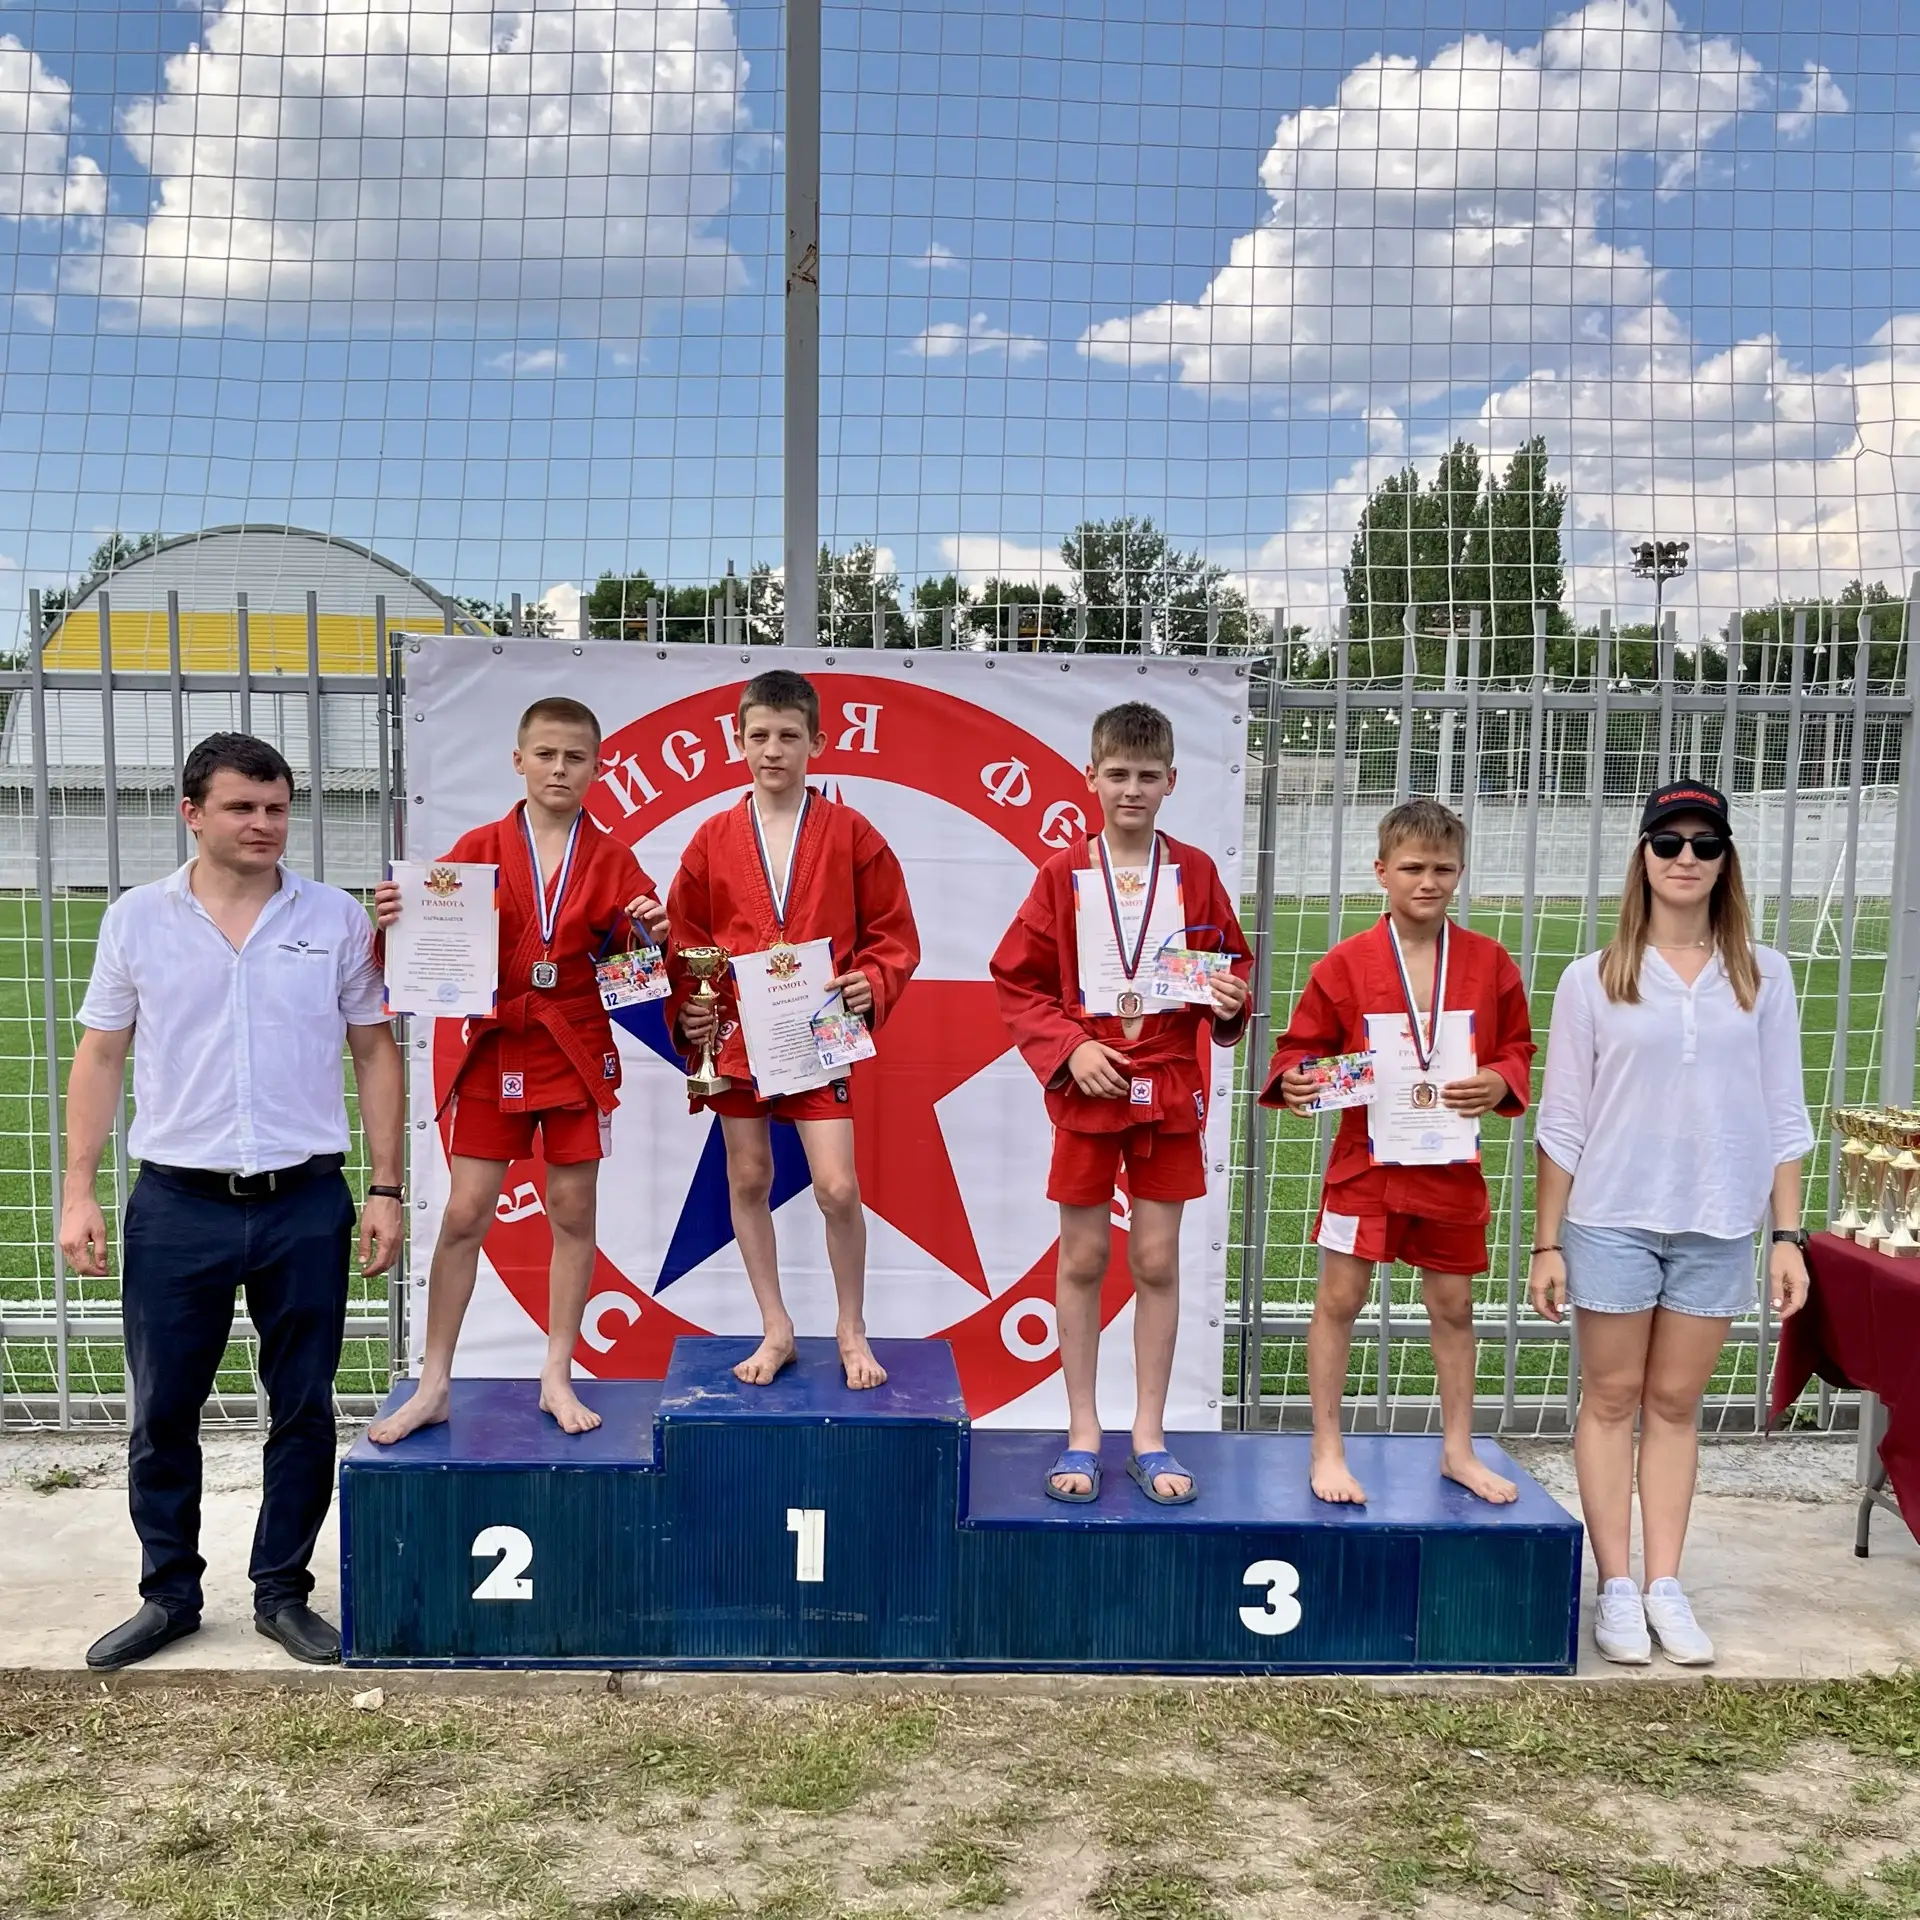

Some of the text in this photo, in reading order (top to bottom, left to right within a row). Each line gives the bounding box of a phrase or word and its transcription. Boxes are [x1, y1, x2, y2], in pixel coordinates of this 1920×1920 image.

[421, 899, 465, 908] ГРАМОТА
[767, 980, 808, 994] ГРАМОТА
[1155, 983, 1170, 996] 12
[604, 993, 618, 1007] 12
[822, 1052, 834, 1066] 12
[786, 1508, 825, 1582] 1
[471, 1525, 533, 1600] 2
[1239, 1559, 1301, 1635] 3
